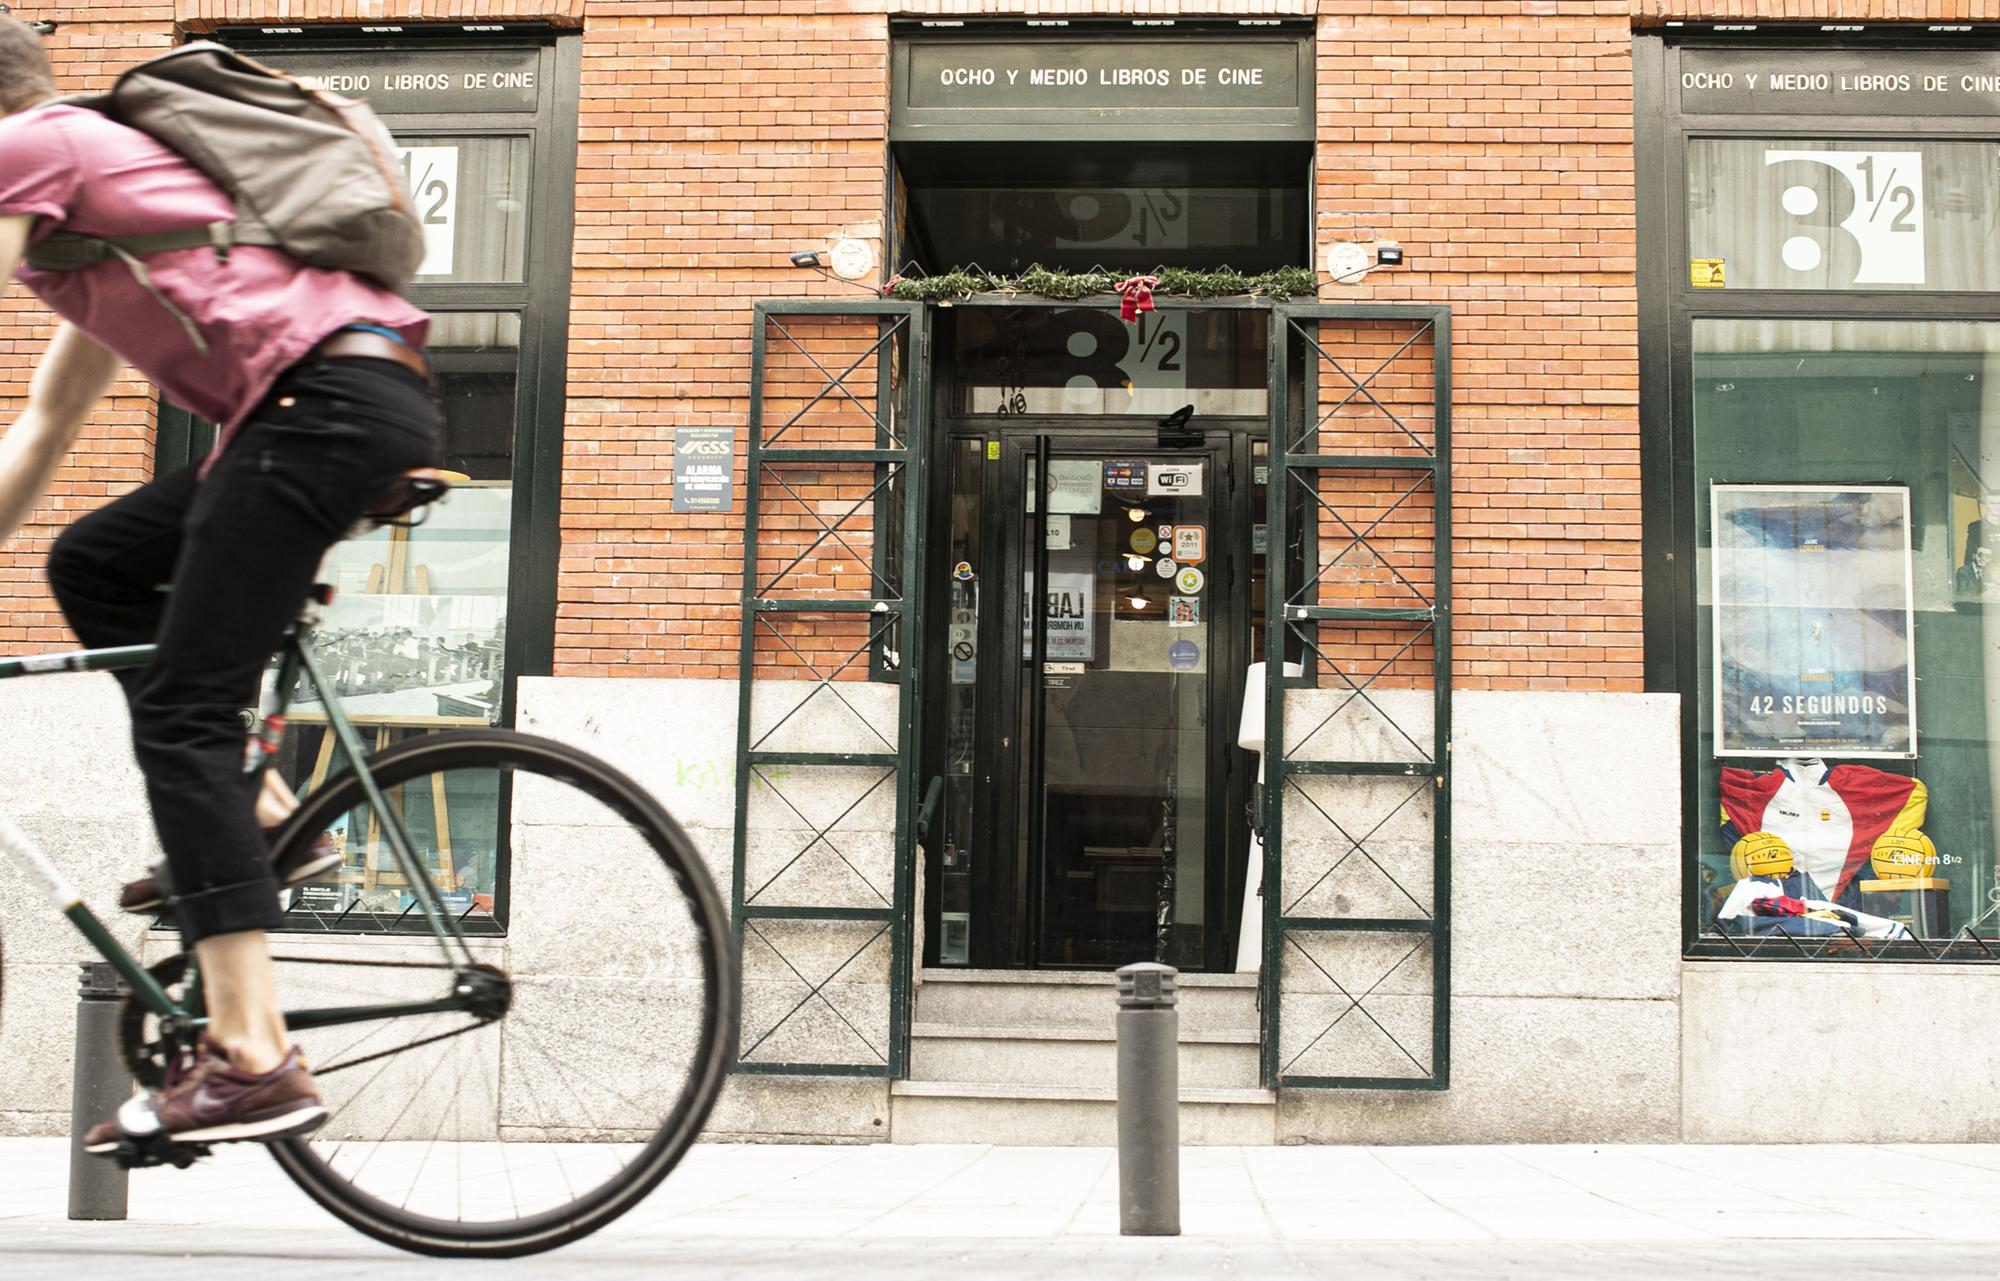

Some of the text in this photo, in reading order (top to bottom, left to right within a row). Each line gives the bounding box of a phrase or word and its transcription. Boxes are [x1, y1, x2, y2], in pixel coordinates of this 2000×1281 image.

[317, 72, 534, 91] MEDIO LIBROS DE CINE
[941, 68, 1263, 86] OCHO Y MEDIO LIBROS DE CINE
[1681, 73, 1733, 89] OCHO
[1745, 74, 1758, 90] Y
[1770, 74, 1828, 90] MEDIO
[1841, 75, 1910, 91] LIBROS
[1924, 76, 1948, 91] DE
[685, 465, 723, 476] ALARMA
[1750, 695, 1887, 715] 42 SEGUNDOS
[1893, 853, 1921, 865] CINE
[1925, 856, 1940, 865] en
